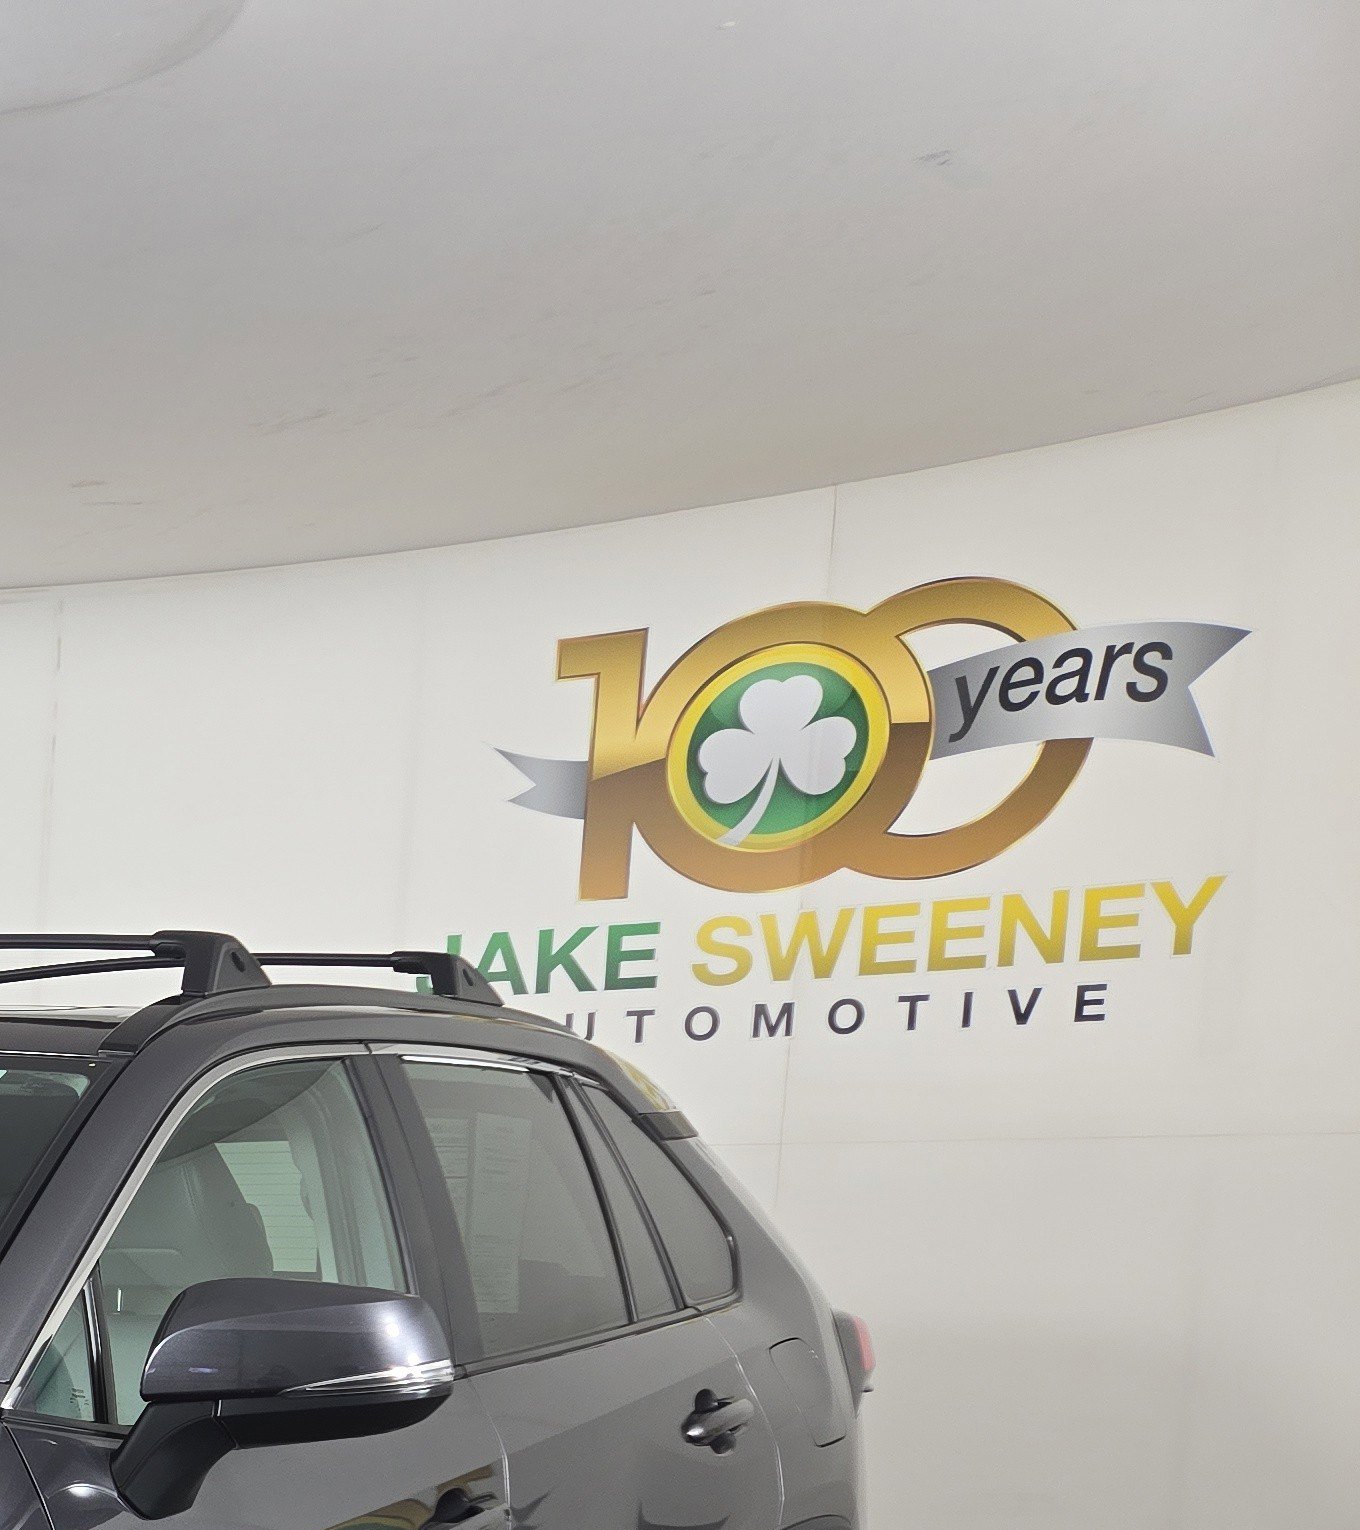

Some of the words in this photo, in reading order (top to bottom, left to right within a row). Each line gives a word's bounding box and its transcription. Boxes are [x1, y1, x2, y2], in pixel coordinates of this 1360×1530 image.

[556, 576, 1094, 900] 100
[948, 639, 1173, 742] years
[692, 875, 1227, 986] SWEENEY
[566, 983, 1108, 1044] UTOMOTIVE
